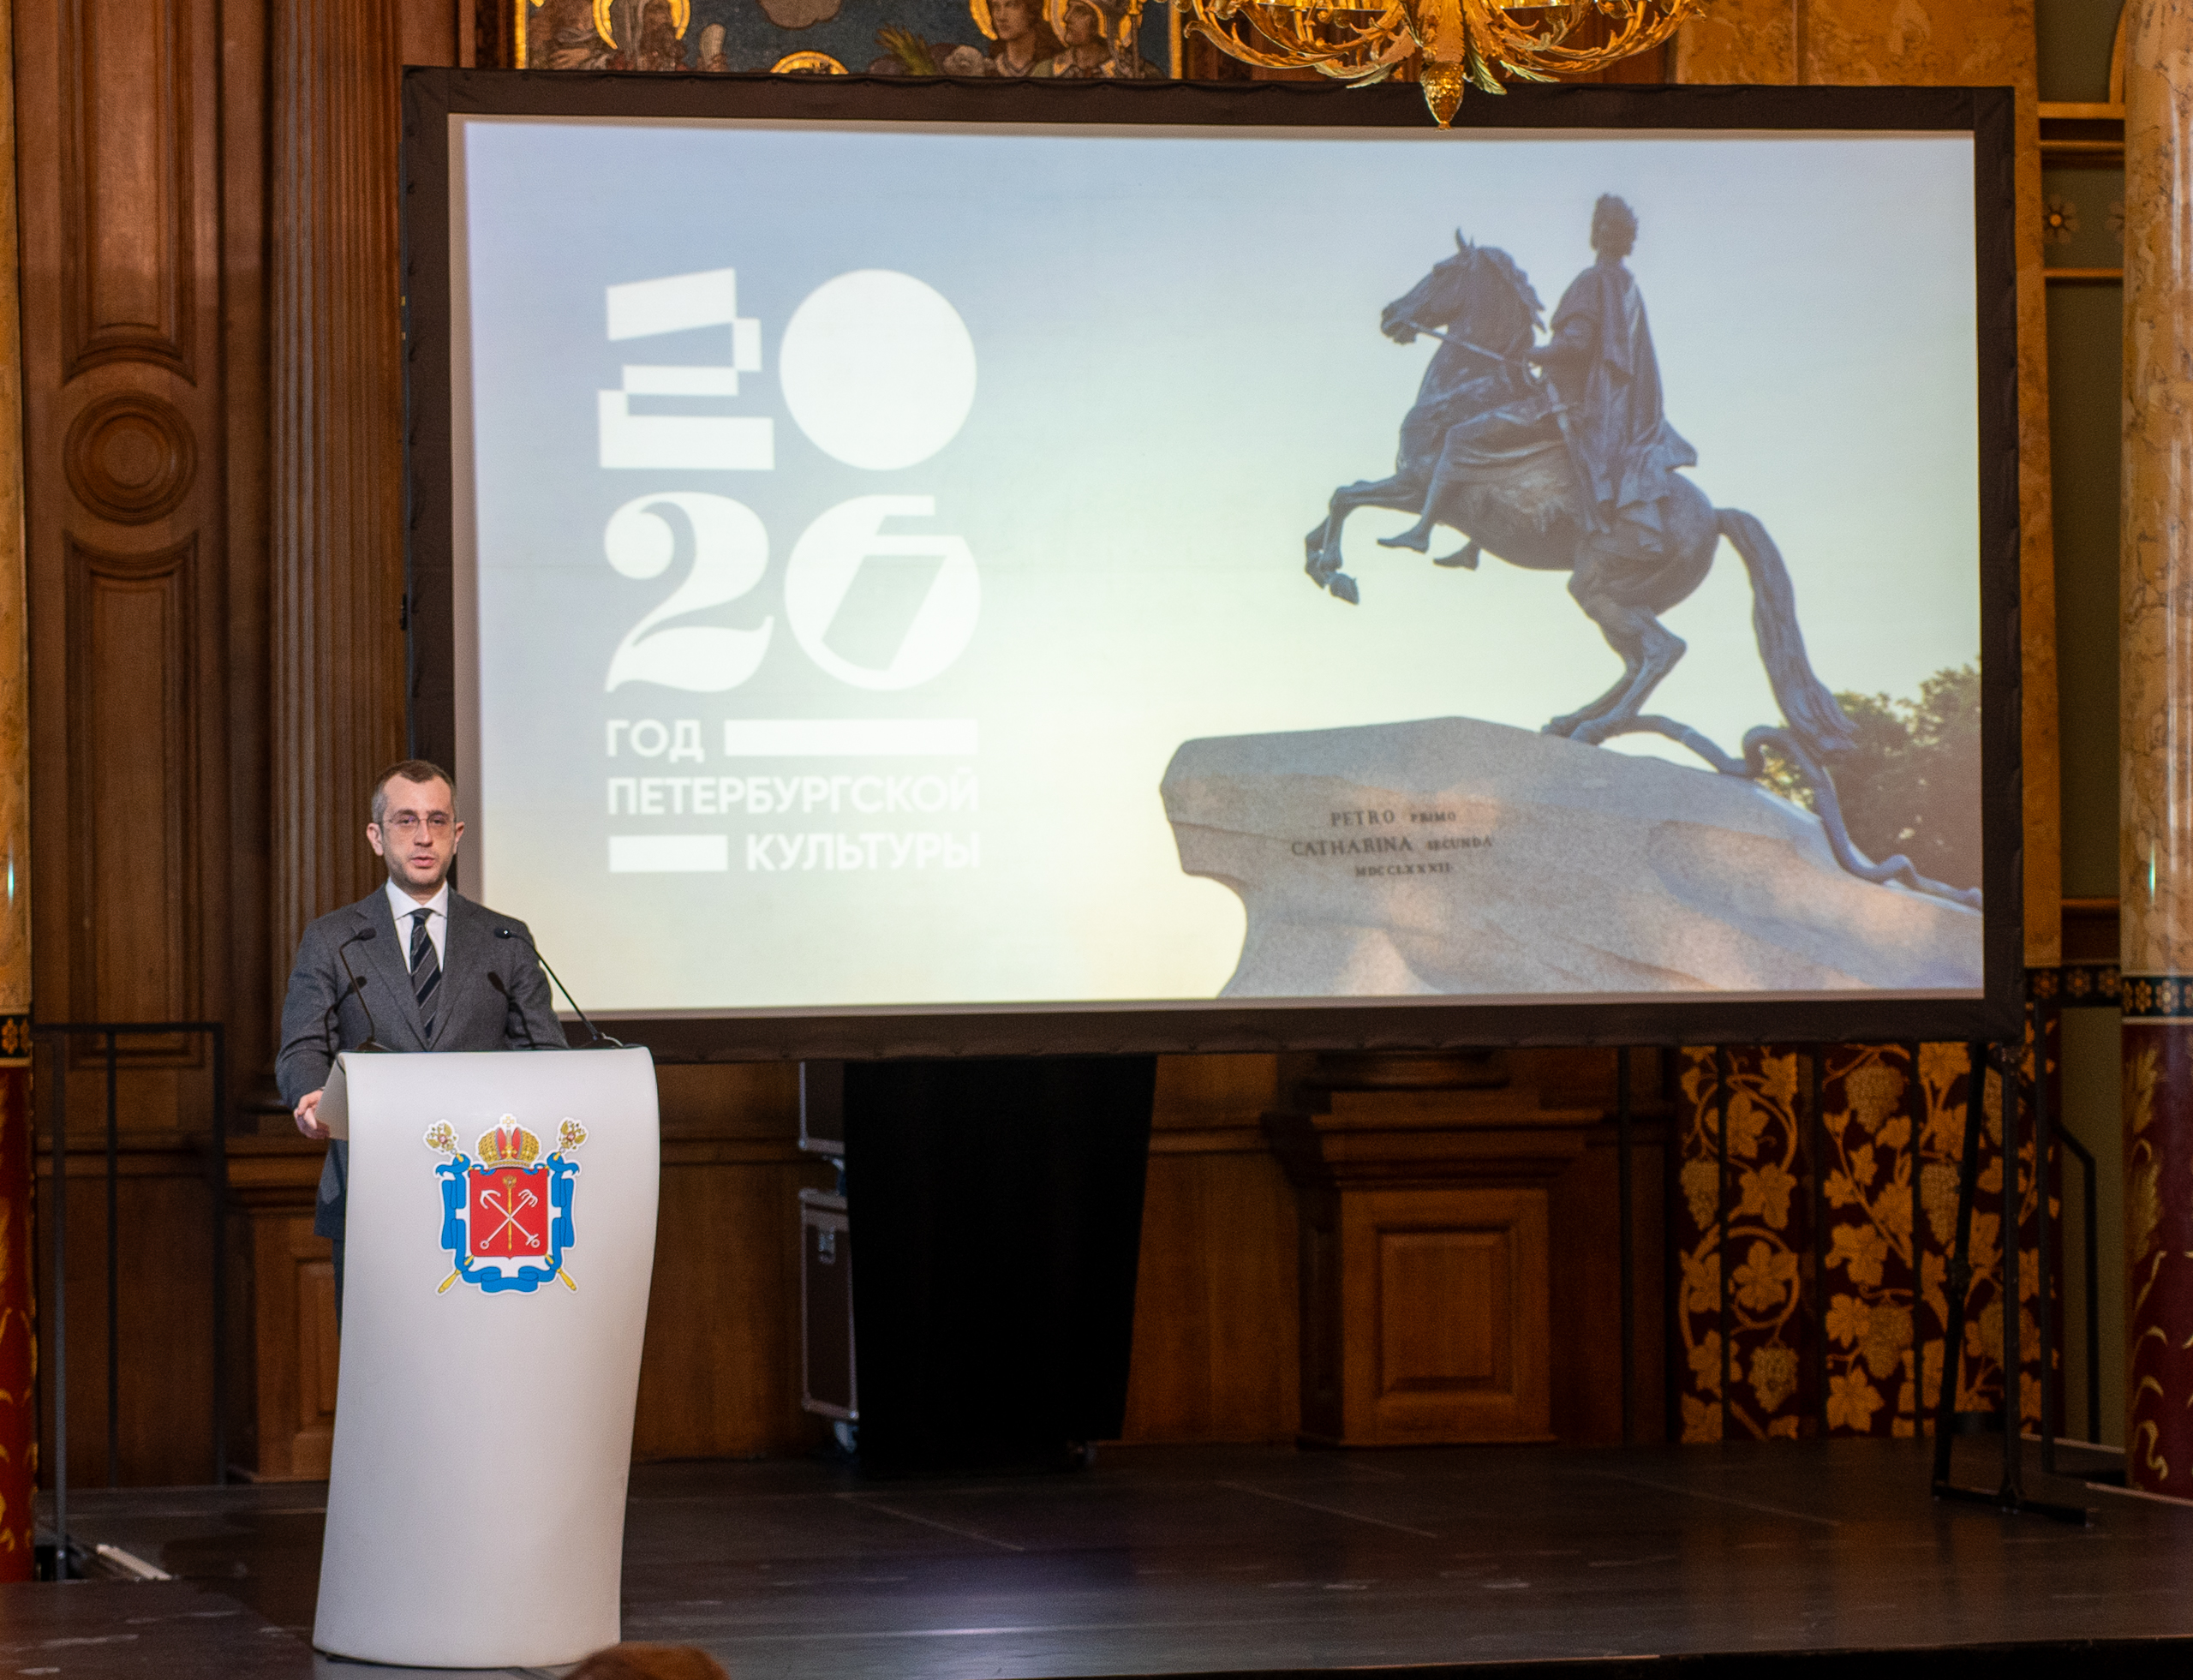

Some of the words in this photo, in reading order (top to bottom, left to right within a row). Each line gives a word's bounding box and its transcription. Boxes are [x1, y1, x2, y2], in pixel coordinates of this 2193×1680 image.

[607, 720, 704, 763] ГОД
[607, 768, 978, 815] ПЕТЕРБУРГСКОЙ
[1331, 810, 1395, 827] PETRO
[1410, 812, 1456, 823] PRIMO
[747, 832, 980, 870] КУЛЬТУРЫ
[1291, 836, 1413, 857] CATHARINA
[1426, 835, 1492, 851] SECUNDA
